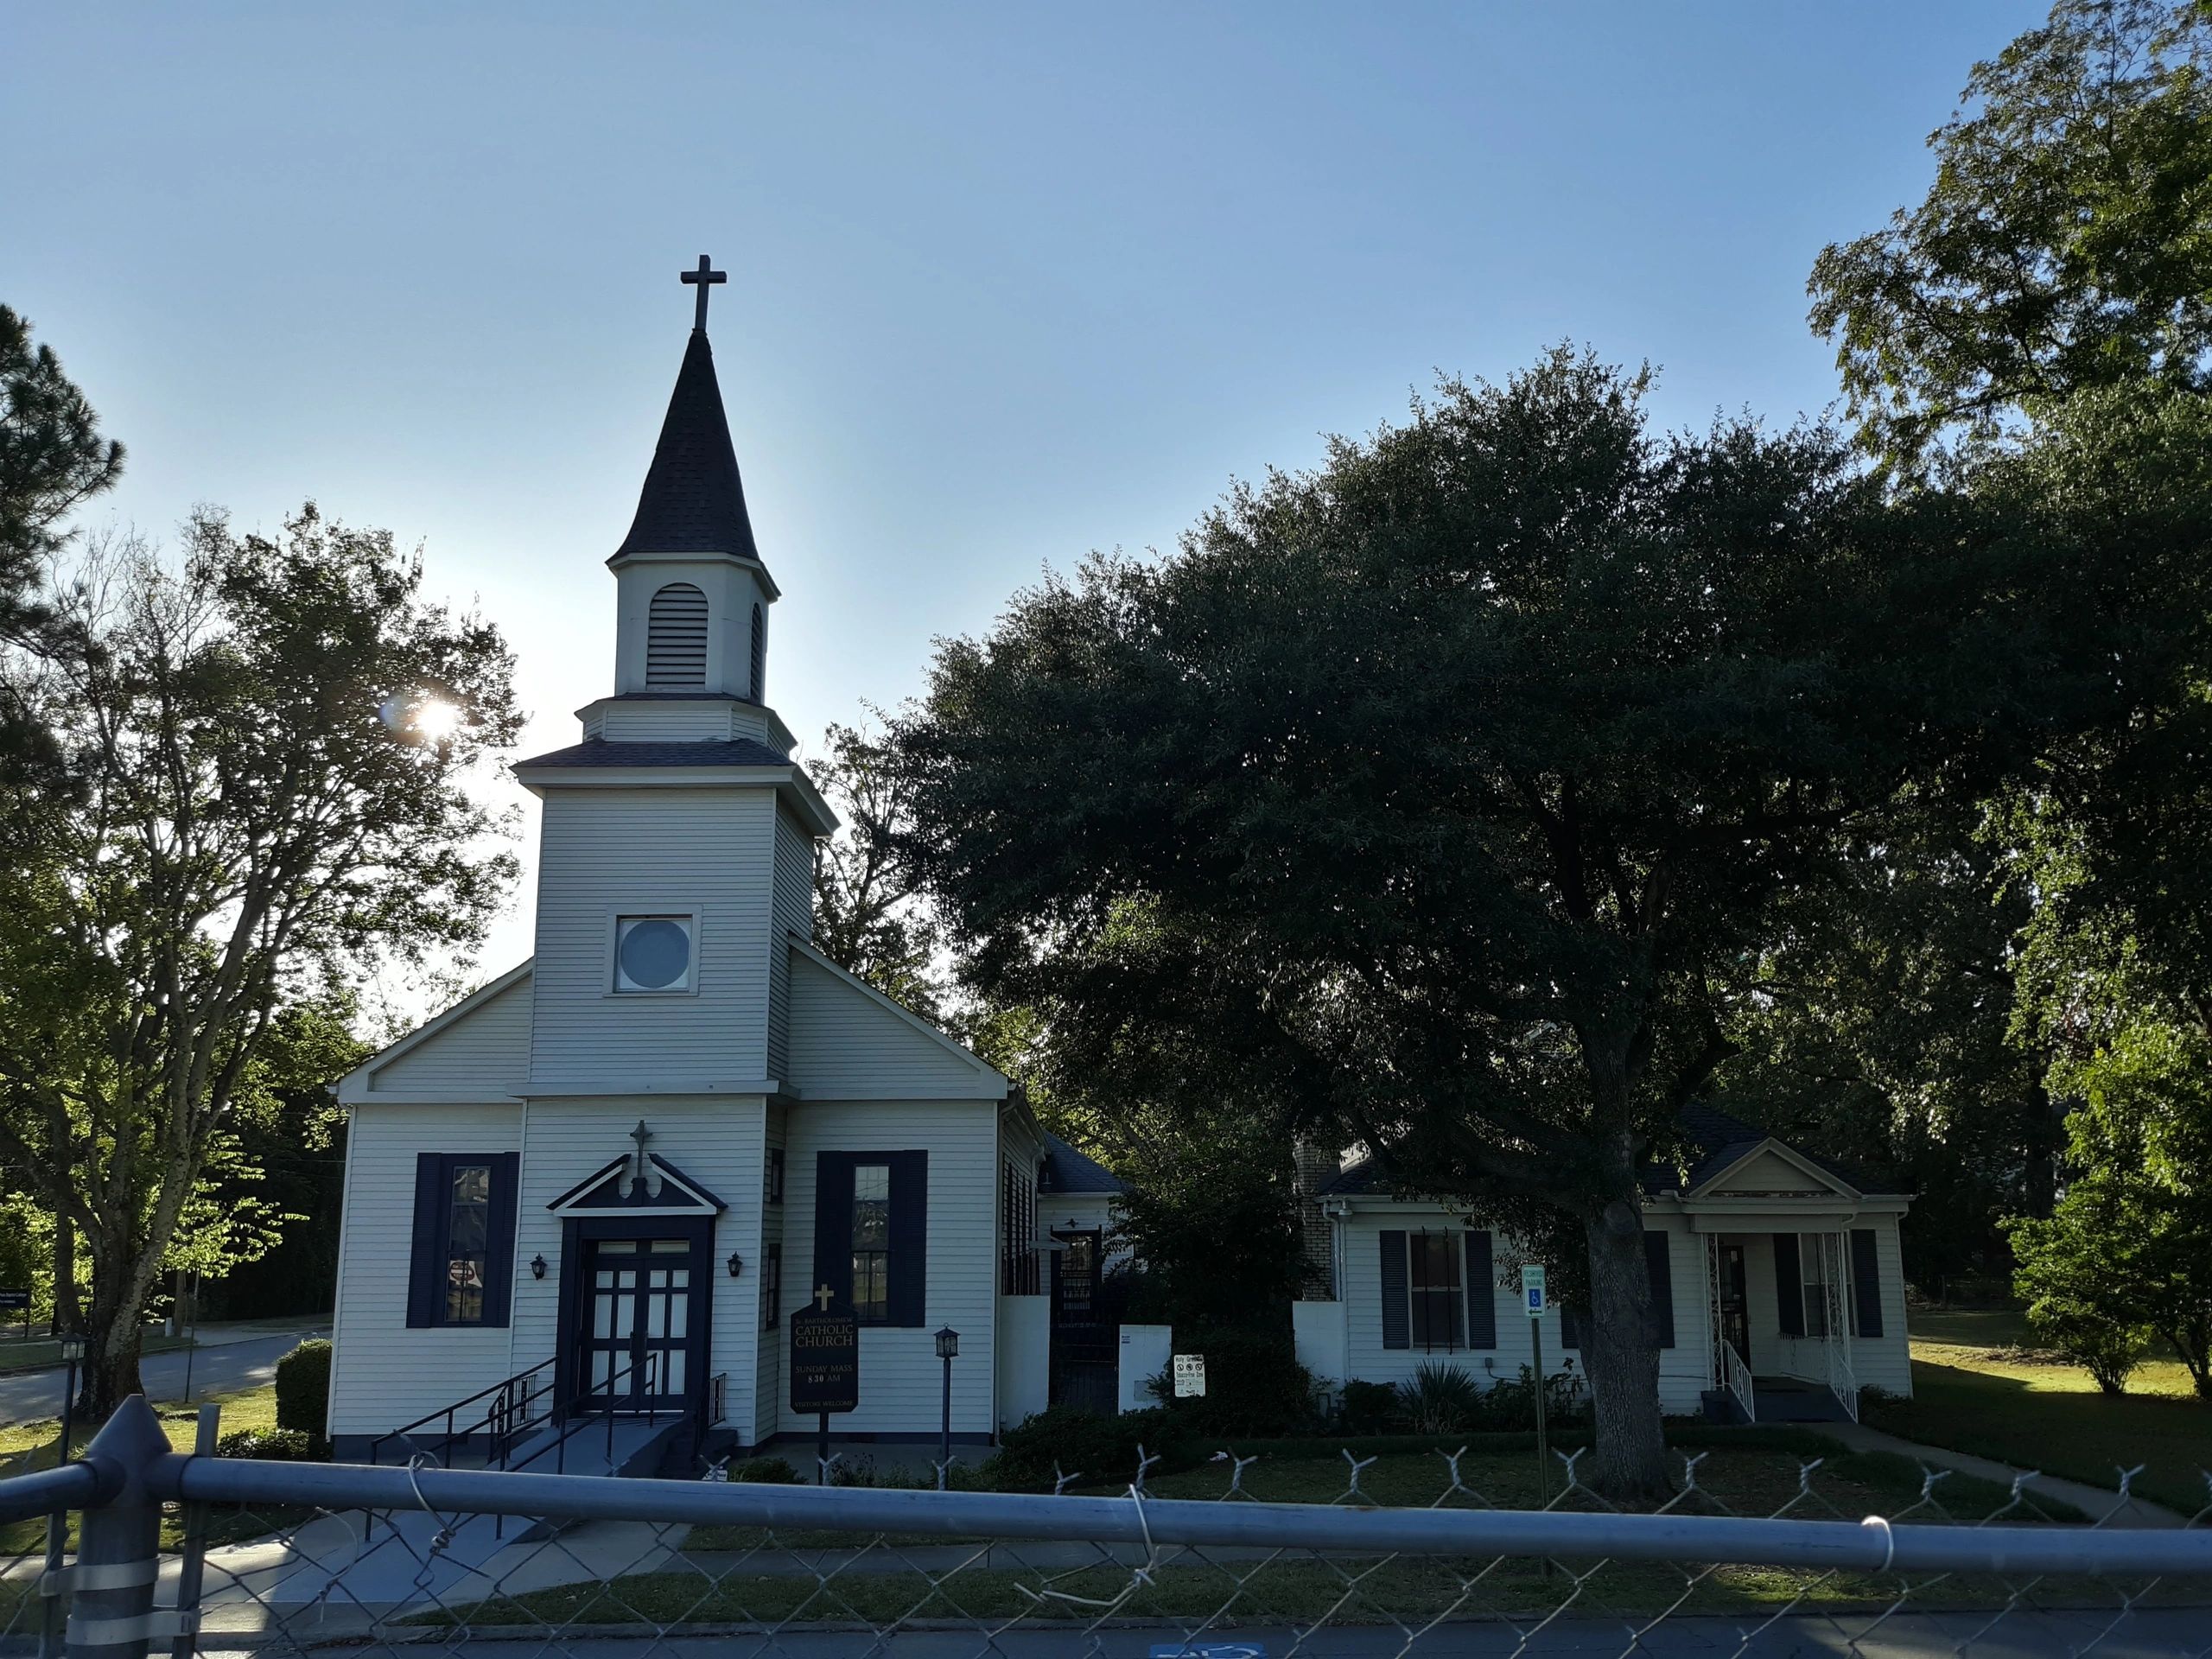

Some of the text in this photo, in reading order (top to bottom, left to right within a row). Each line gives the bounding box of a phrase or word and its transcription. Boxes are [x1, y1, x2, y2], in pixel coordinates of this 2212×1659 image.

[795, 1324, 854, 1336] CATHOLIC
[795, 1335, 853, 1348] CHURCH
[795, 1365, 828, 1374] SUNDAY
